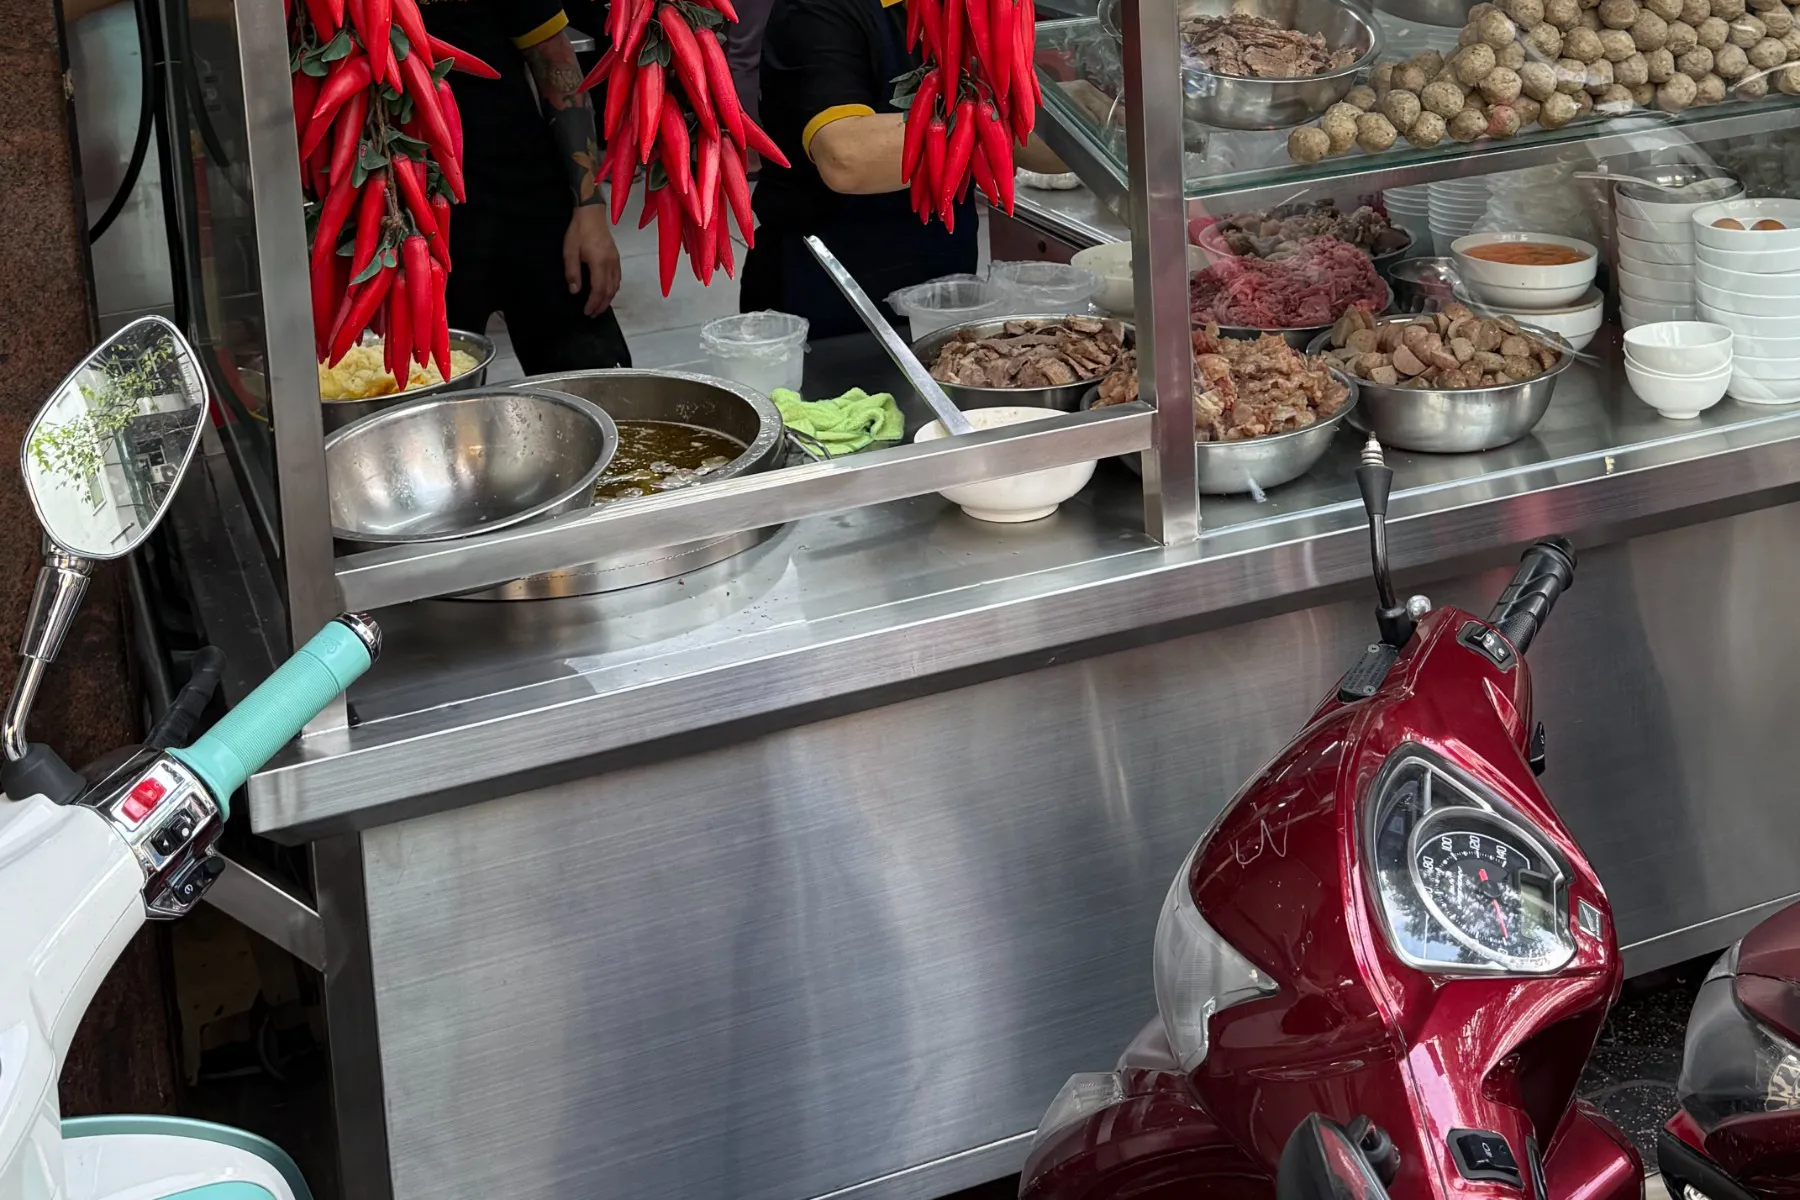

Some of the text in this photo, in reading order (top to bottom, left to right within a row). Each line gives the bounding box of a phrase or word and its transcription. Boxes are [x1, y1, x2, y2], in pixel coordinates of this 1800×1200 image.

[1441, 836, 1453, 851] 100
[1470, 835, 1480, 850] 120
[1496, 845, 1507, 860] 140
